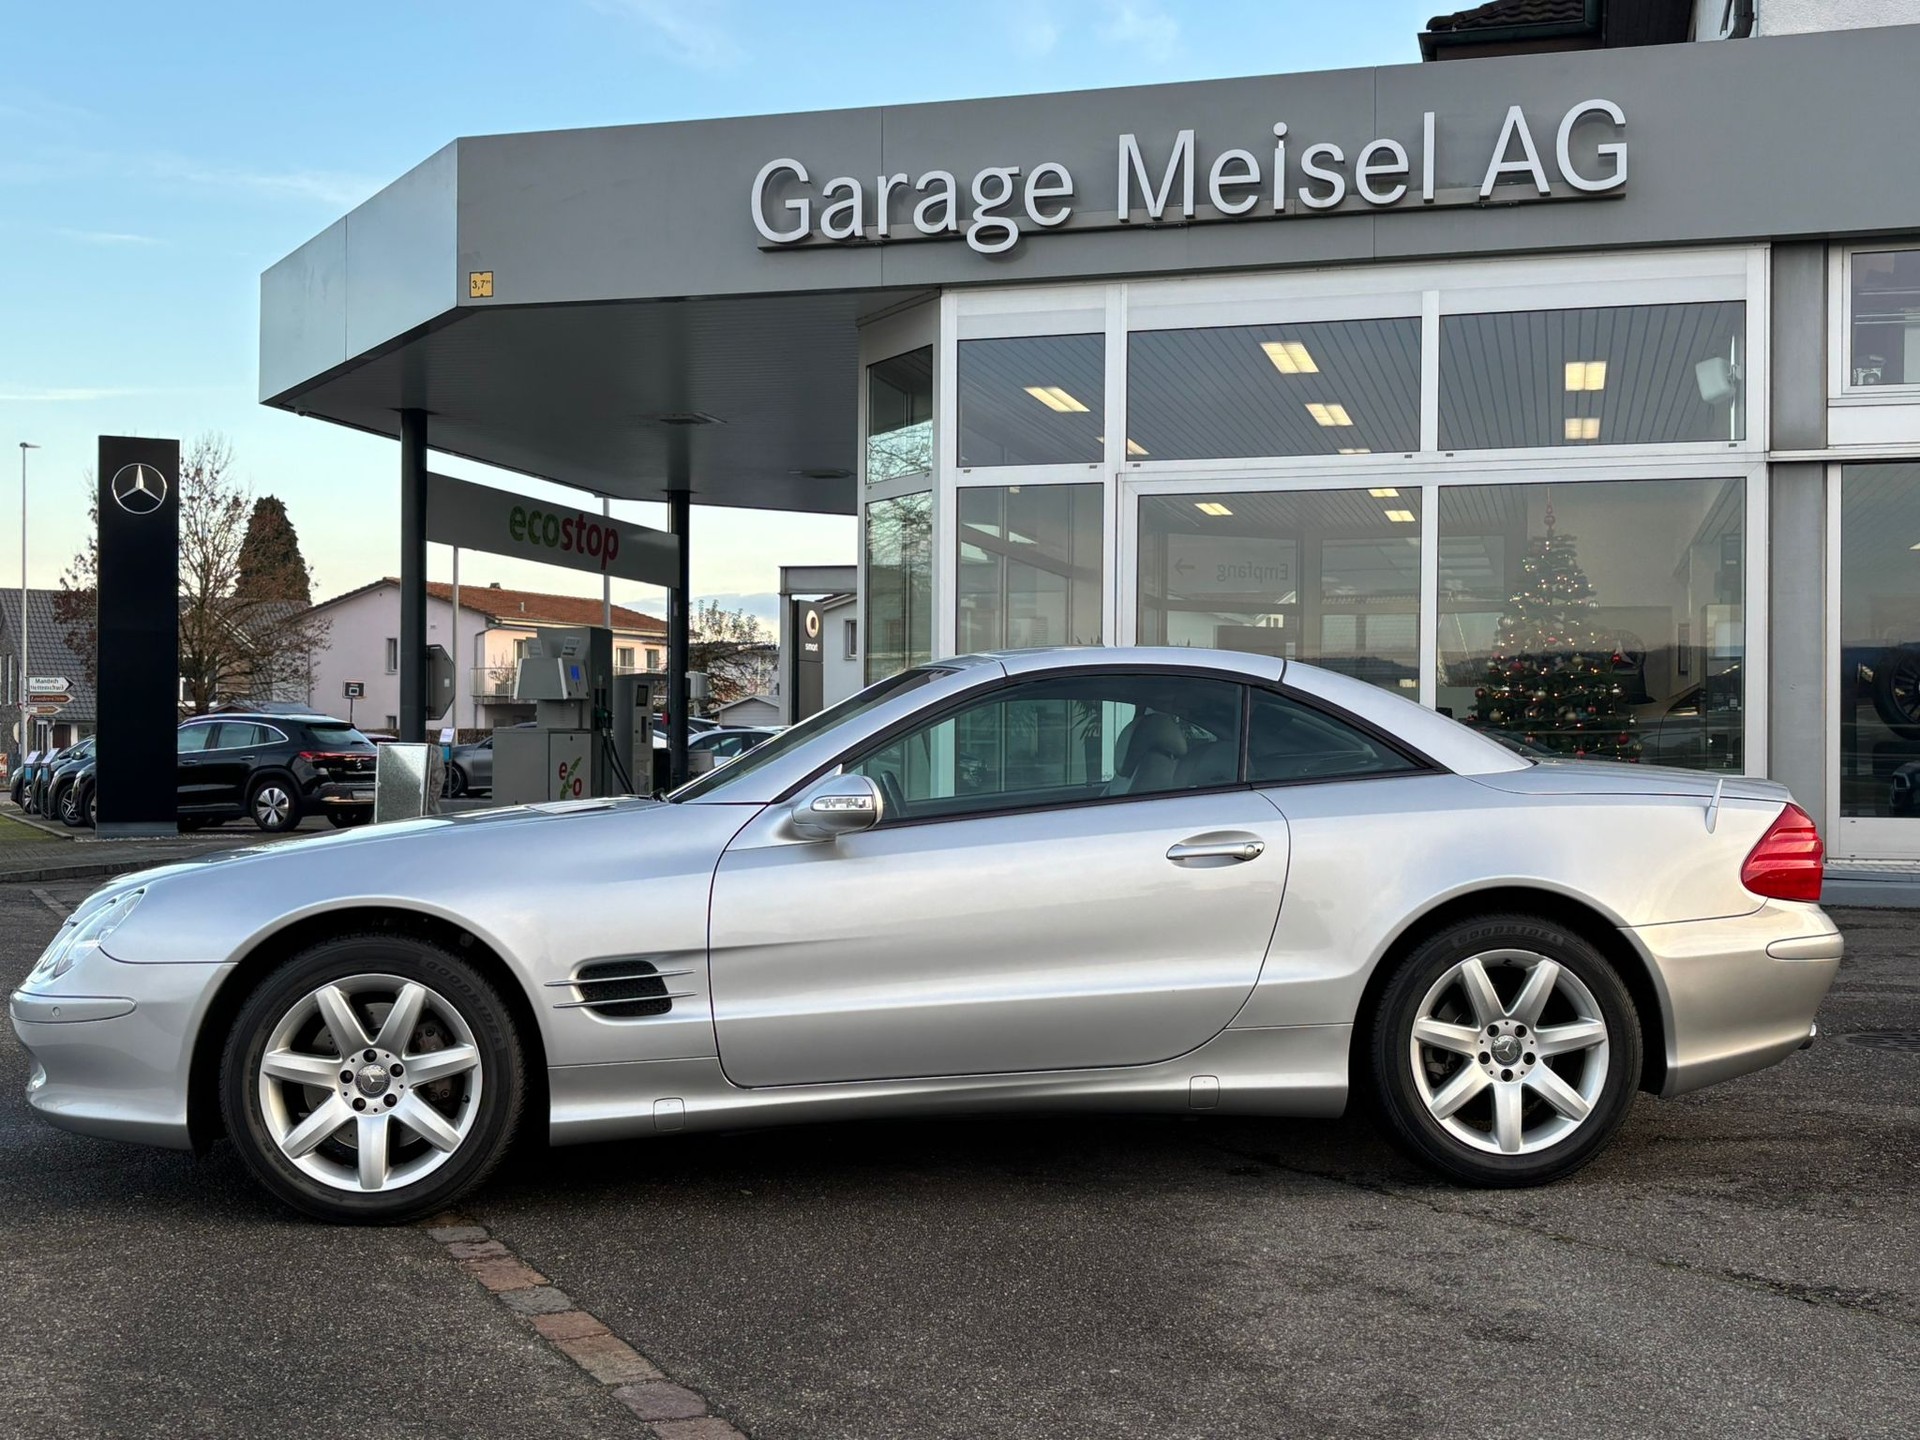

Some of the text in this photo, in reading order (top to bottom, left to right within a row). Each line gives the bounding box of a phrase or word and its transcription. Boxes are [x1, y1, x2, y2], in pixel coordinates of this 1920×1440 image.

[751, 98, 1627, 253] Garage Meisel AG
[509, 505, 619, 571] ecostop
